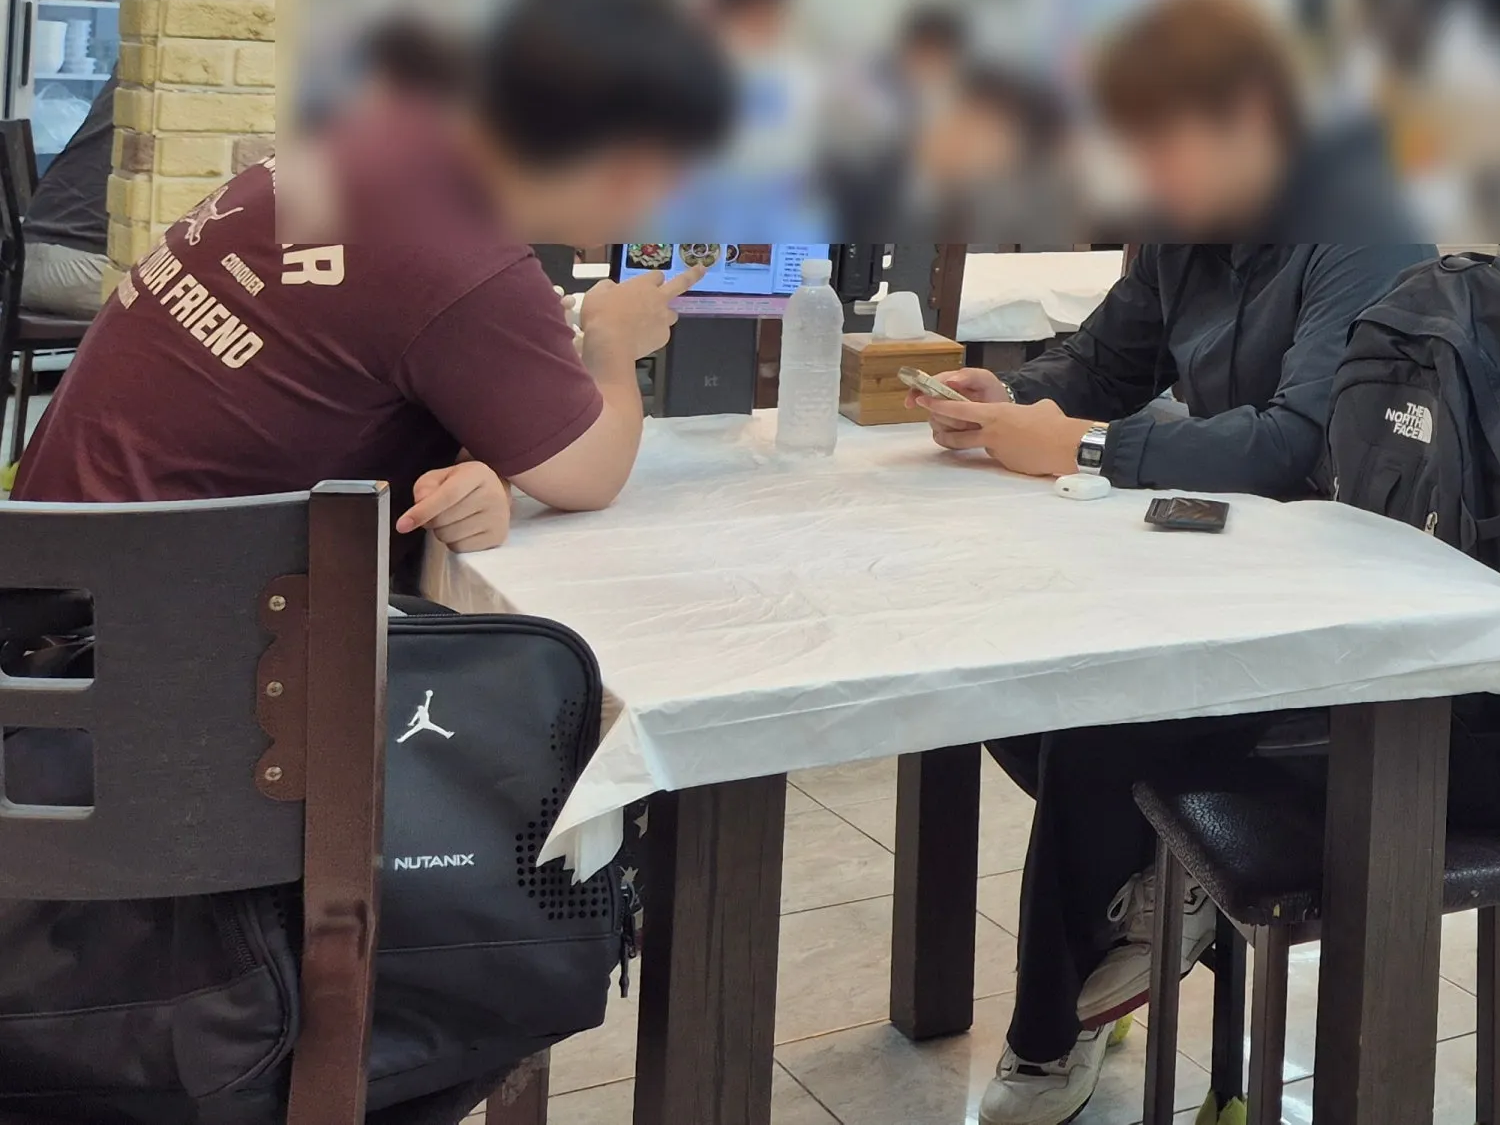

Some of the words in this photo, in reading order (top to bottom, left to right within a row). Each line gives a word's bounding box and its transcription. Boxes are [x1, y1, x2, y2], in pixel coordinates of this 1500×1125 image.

[221, 252, 265, 297] CONQUER
[159, 273, 264, 369] FRIEND
[704, 375, 719, 386] kt
[1384, 407, 1423, 428] NORTH
[1406, 402, 1424, 418] THE
[1393, 422, 1419, 439] FACE
[394, 853, 475, 871] NUTANIX
